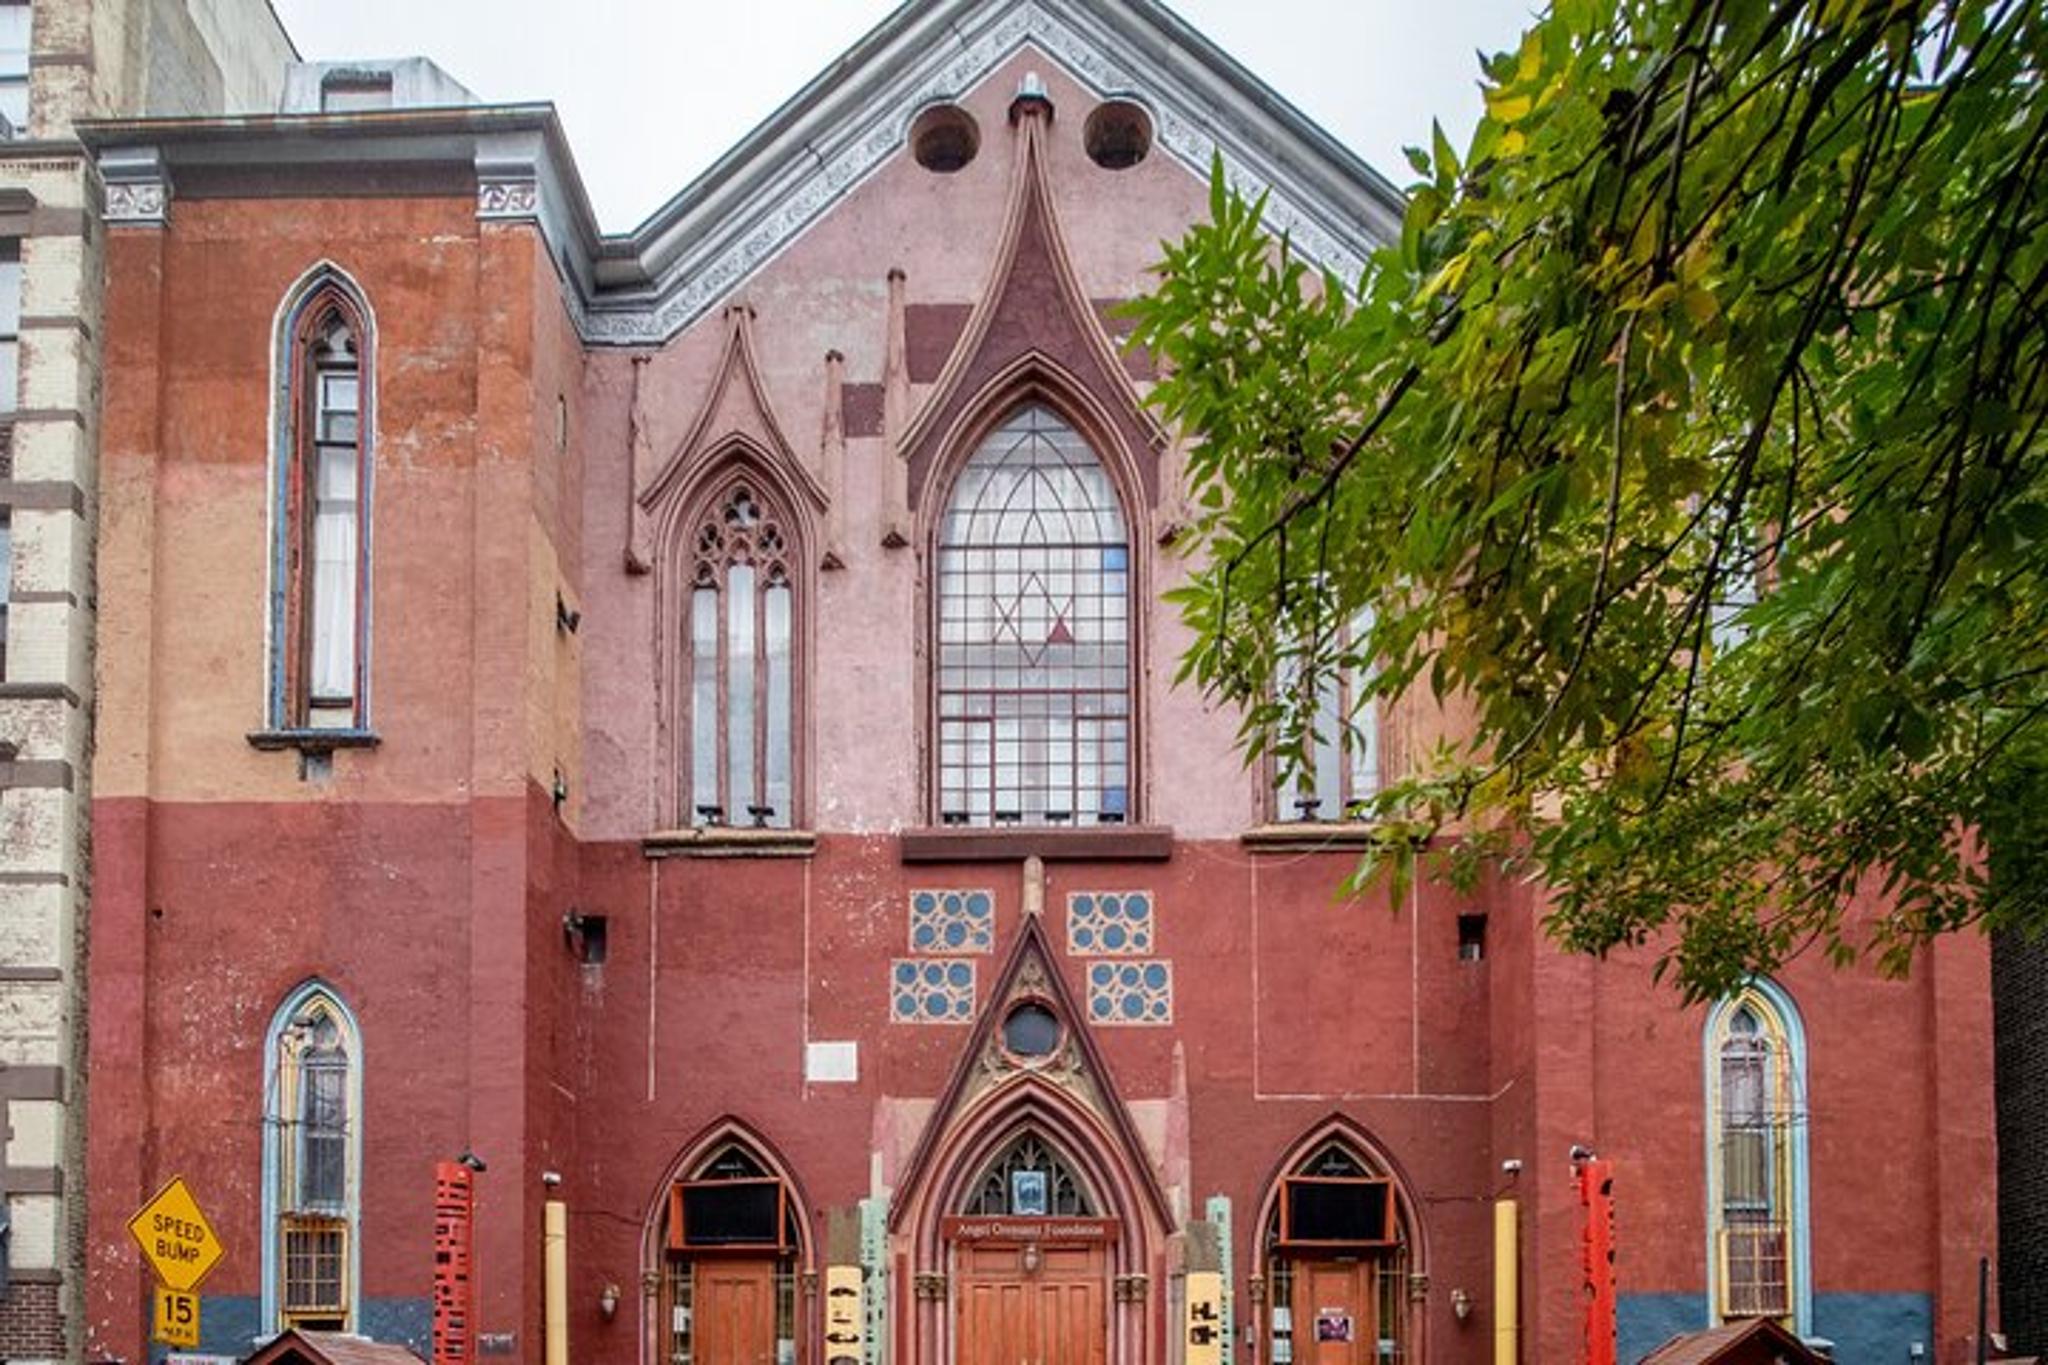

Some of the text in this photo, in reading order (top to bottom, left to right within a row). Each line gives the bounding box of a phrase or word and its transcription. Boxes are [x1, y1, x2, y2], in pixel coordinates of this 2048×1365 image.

[153, 1213, 205, 1243] SPEED
[155, 1239, 200, 1264] BUMP
[164, 1295, 193, 1324] 15
